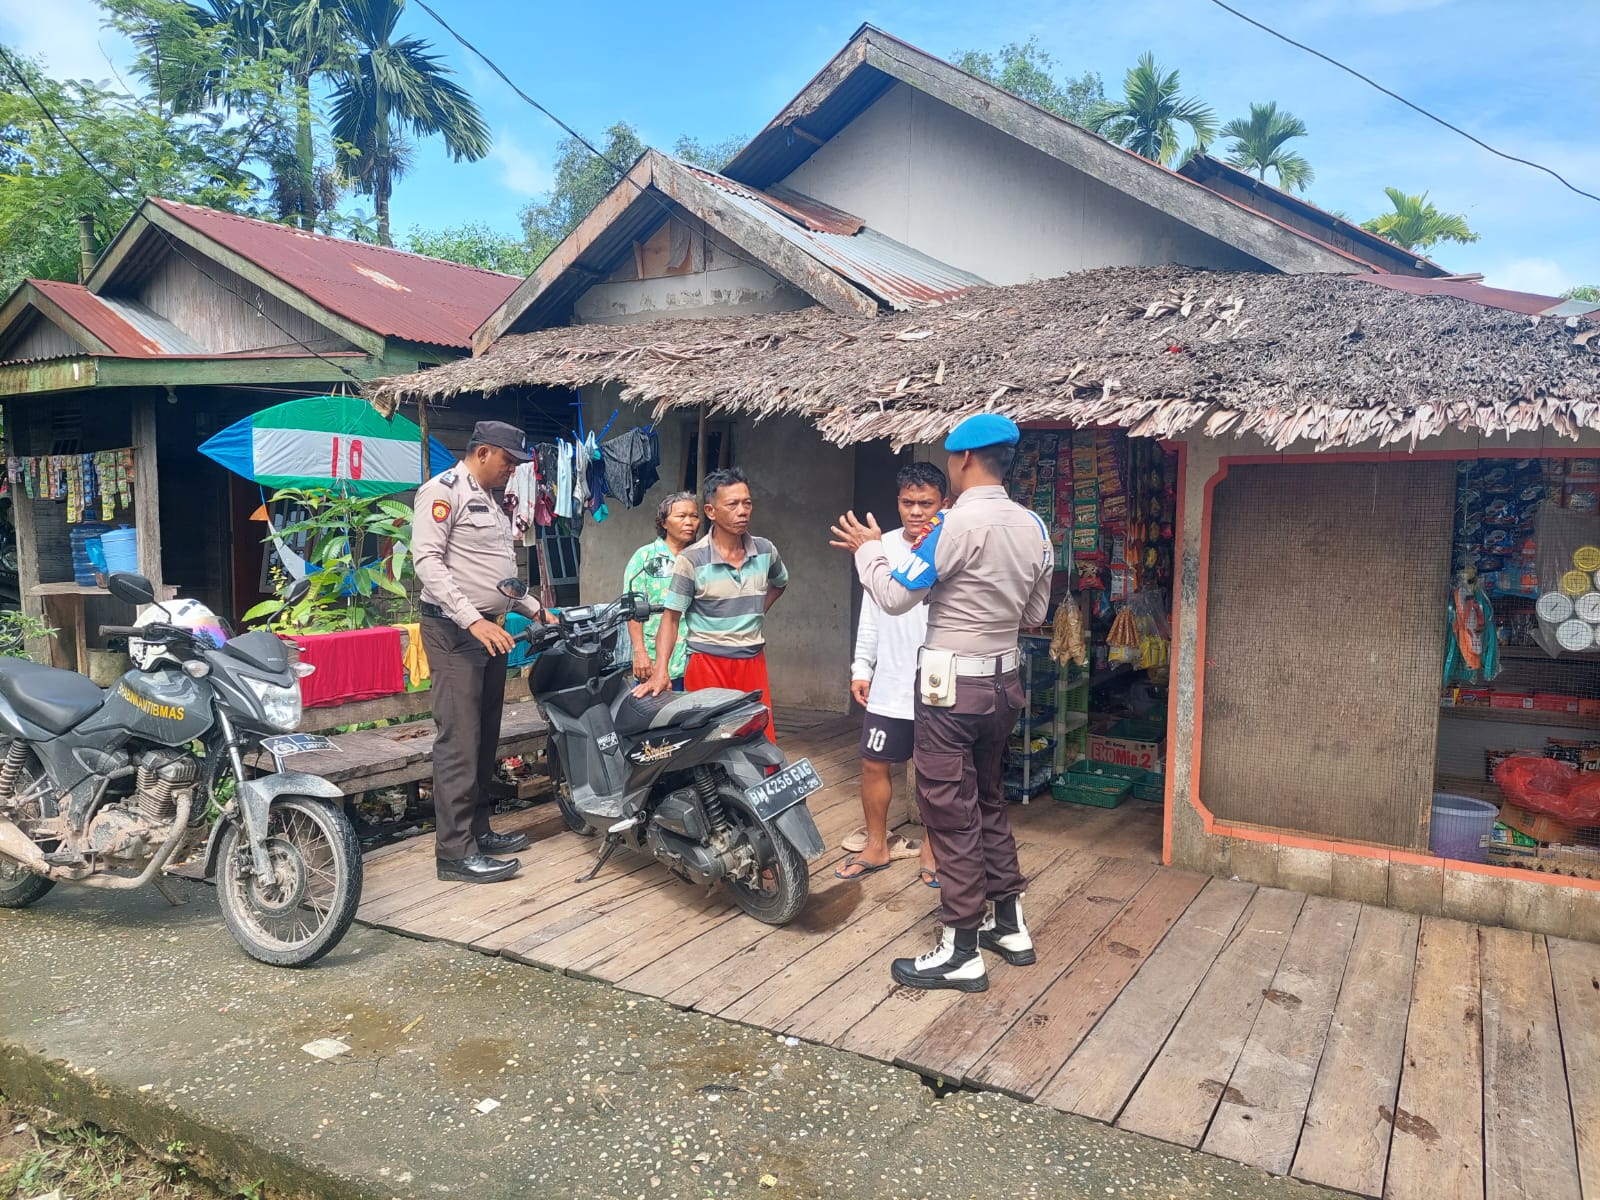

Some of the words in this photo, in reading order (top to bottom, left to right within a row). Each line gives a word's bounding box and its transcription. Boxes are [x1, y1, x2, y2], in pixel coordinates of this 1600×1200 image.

[867, 727, 886, 752] 10
[1141, 752, 1152, 769] 2
[748, 787, 770, 806] BM
[765, 774, 793, 795] 4256
